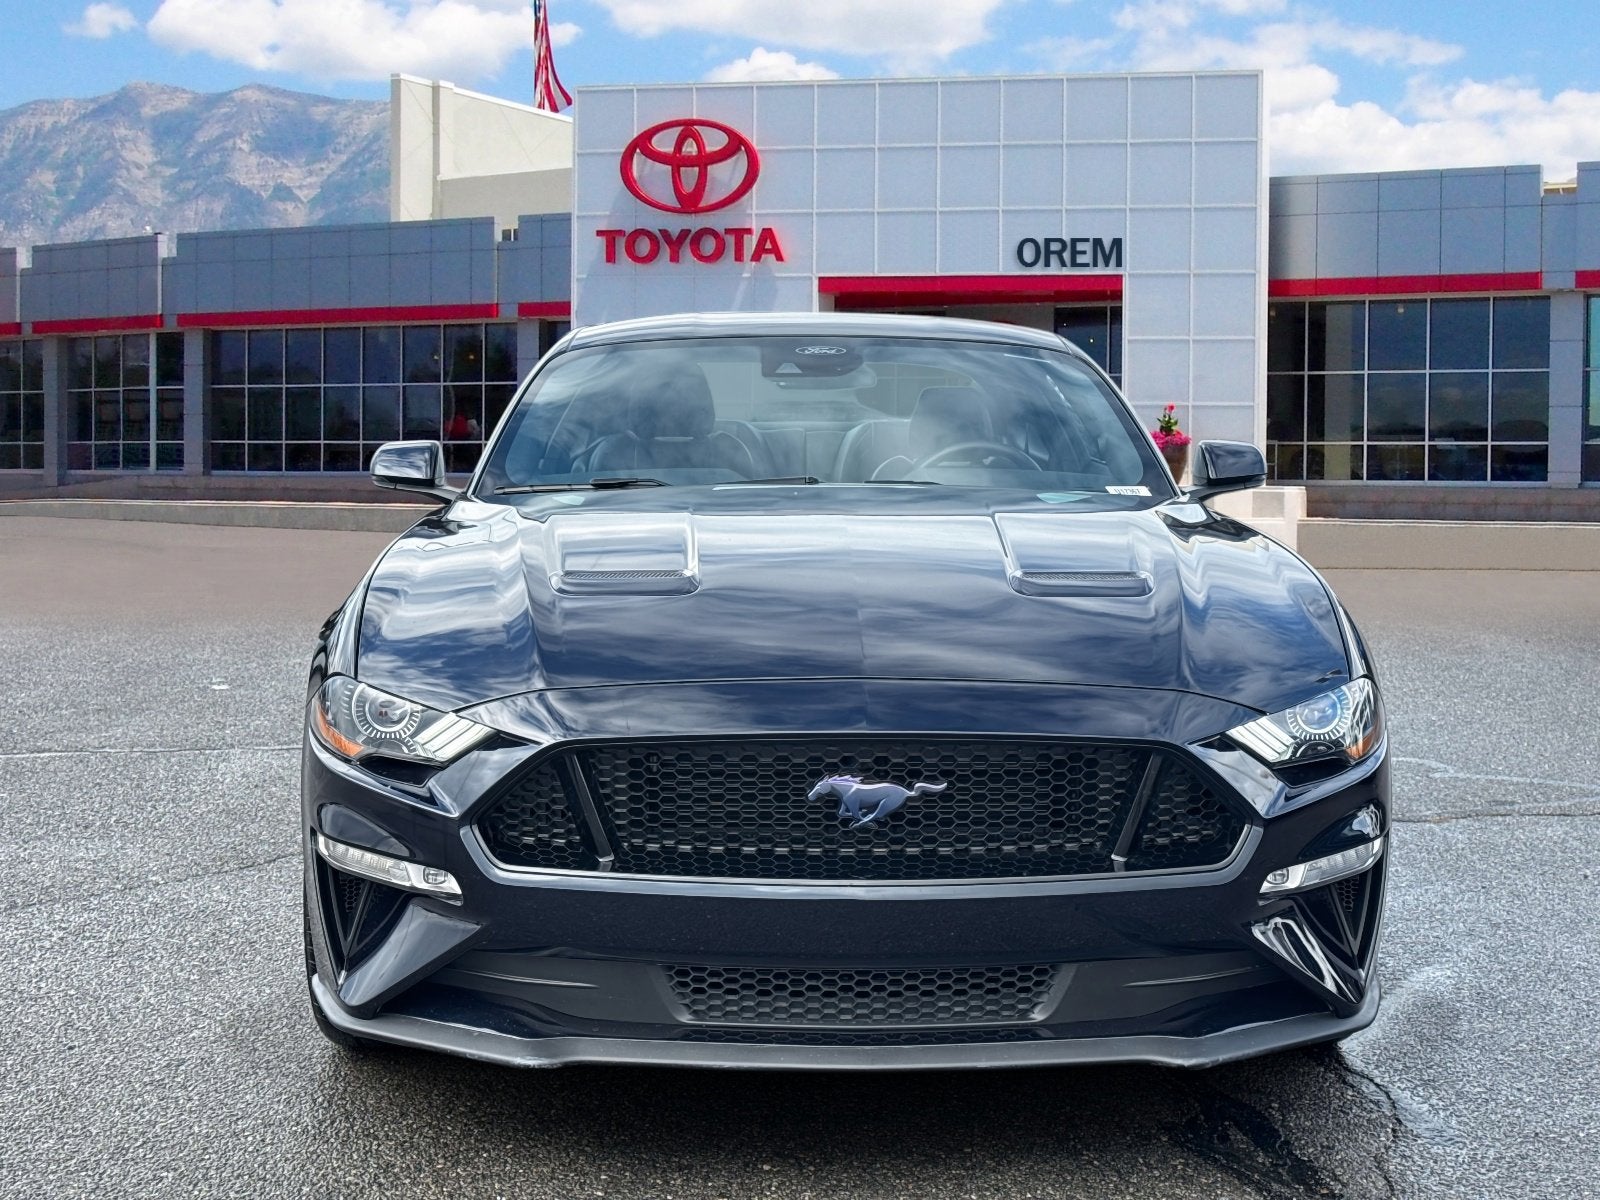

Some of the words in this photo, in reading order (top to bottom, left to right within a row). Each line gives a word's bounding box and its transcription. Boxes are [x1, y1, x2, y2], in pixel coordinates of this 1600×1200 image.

[596, 227, 784, 265] TOYOTA
[1017, 237, 1122, 268] OREM
[802, 346, 840, 355] Ford
